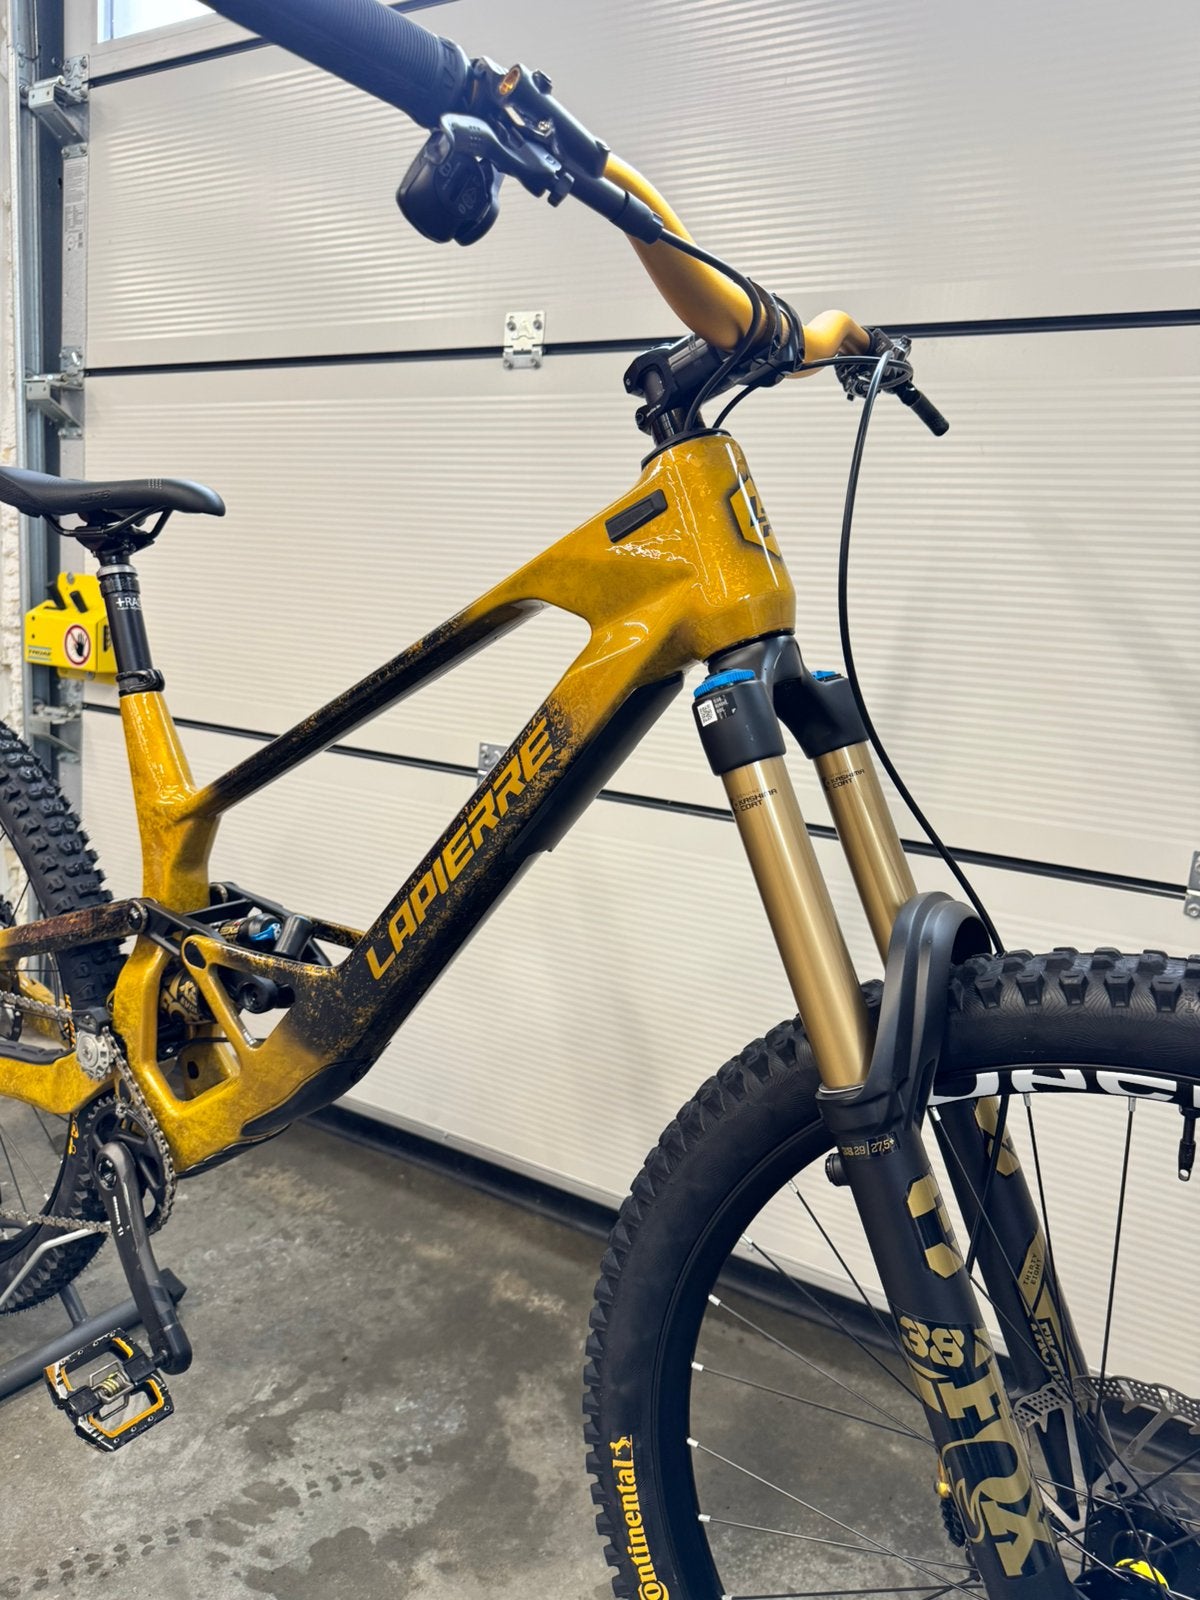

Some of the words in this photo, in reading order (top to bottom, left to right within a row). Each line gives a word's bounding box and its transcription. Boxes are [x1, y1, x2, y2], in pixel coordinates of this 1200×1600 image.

[366, 717, 554, 980] LAPIERRE
[739, 799, 763, 812] COAT
[900, 1315, 965, 1368] 38
[938, 1362, 1058, 1577] FOX
